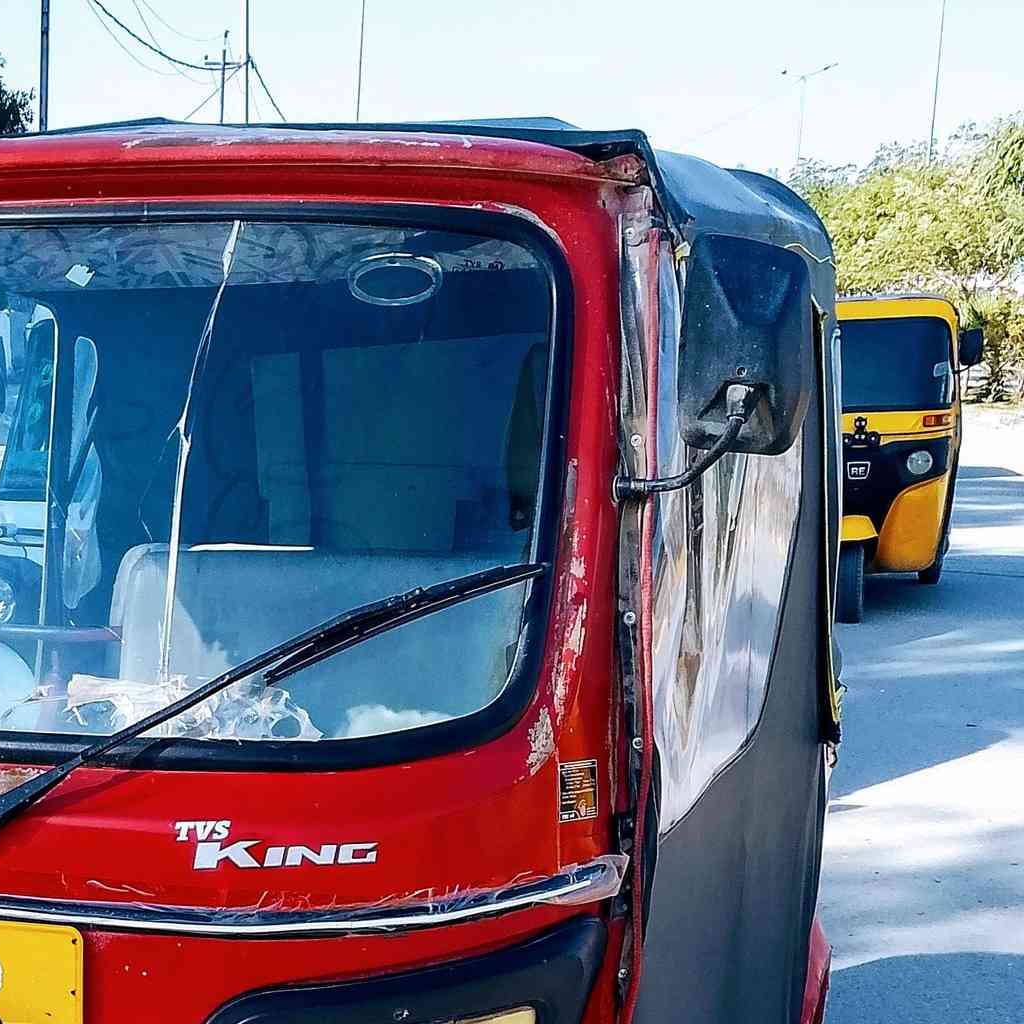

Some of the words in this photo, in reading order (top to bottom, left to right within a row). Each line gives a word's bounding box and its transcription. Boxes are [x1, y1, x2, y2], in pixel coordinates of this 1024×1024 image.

[850, 466, 866, 476] RE
[174, 820, 231, 842] TVS
[192, 840, 379, 870] KING
